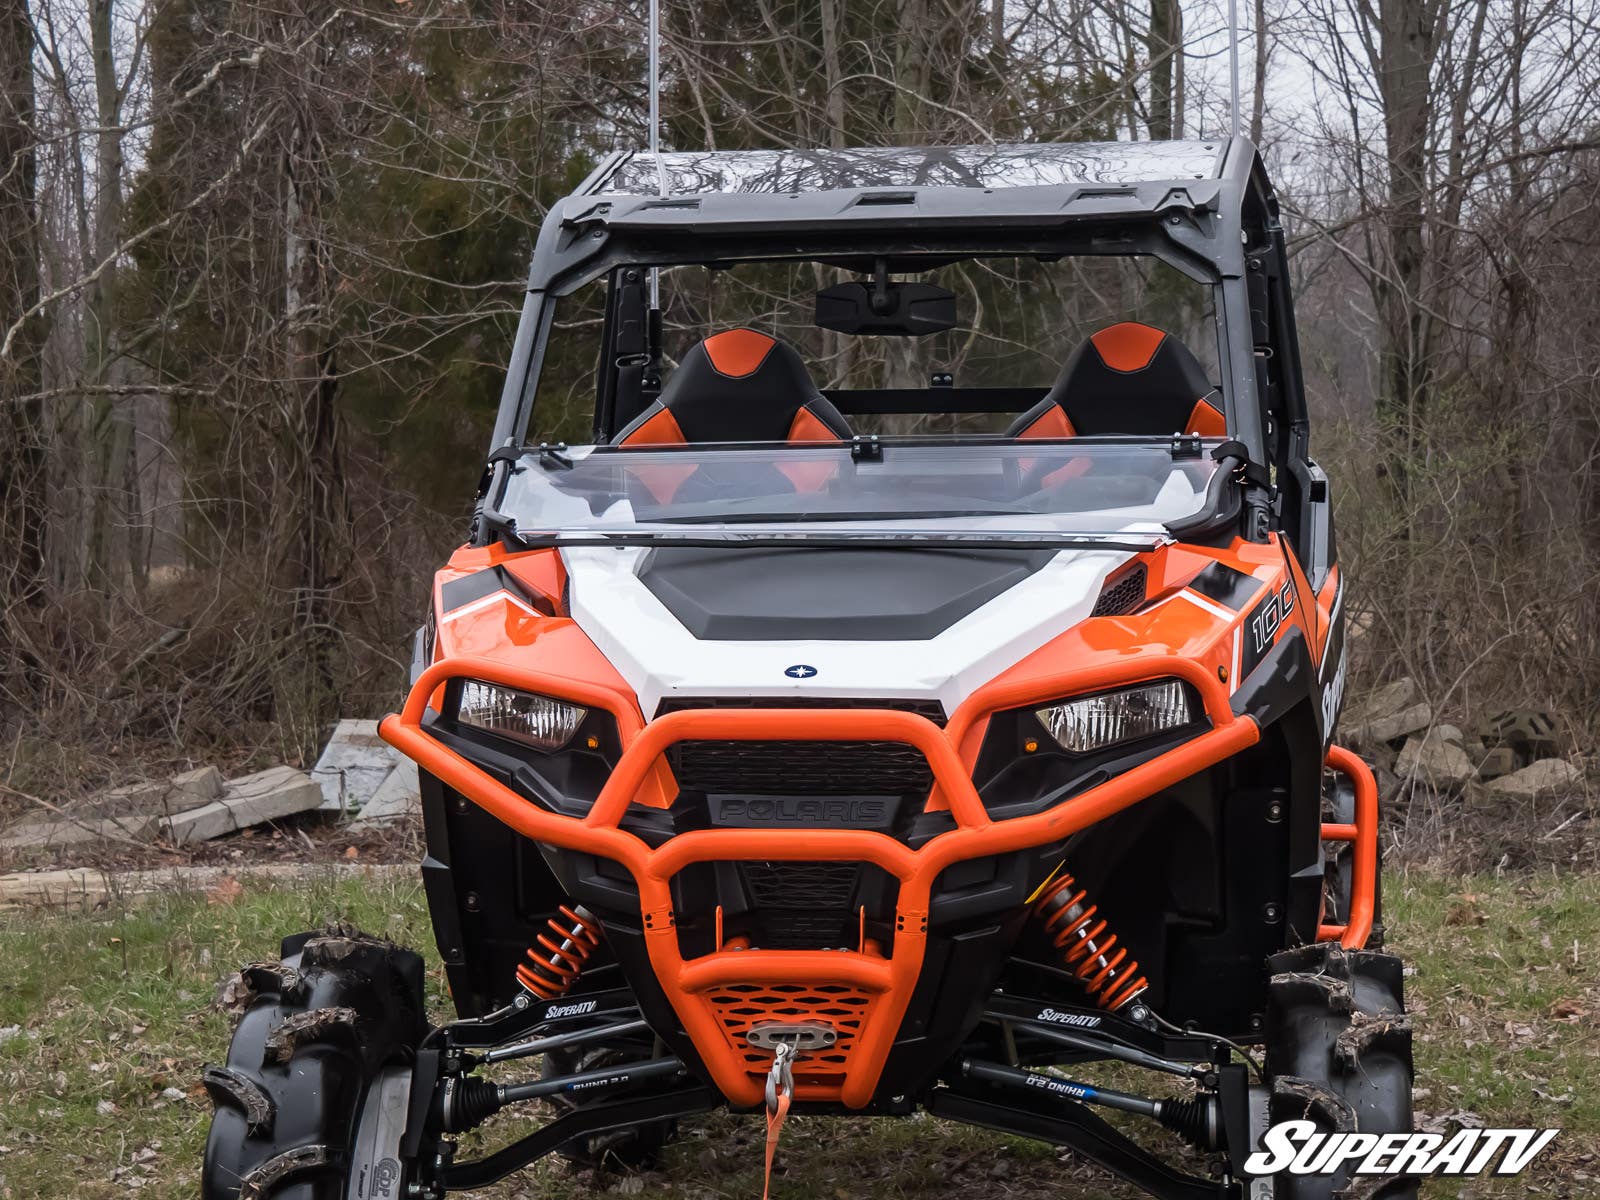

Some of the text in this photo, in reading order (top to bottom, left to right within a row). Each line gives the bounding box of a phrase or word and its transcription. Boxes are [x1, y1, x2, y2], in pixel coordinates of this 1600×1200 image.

[719, 799, 885, 822] POLARIS
[545, 1001, 598, 1019] SUPERATV
[1037, 1008, 1101, 1027] SUPERATV
[1047, 1081, 1086, 1097] RHINO
